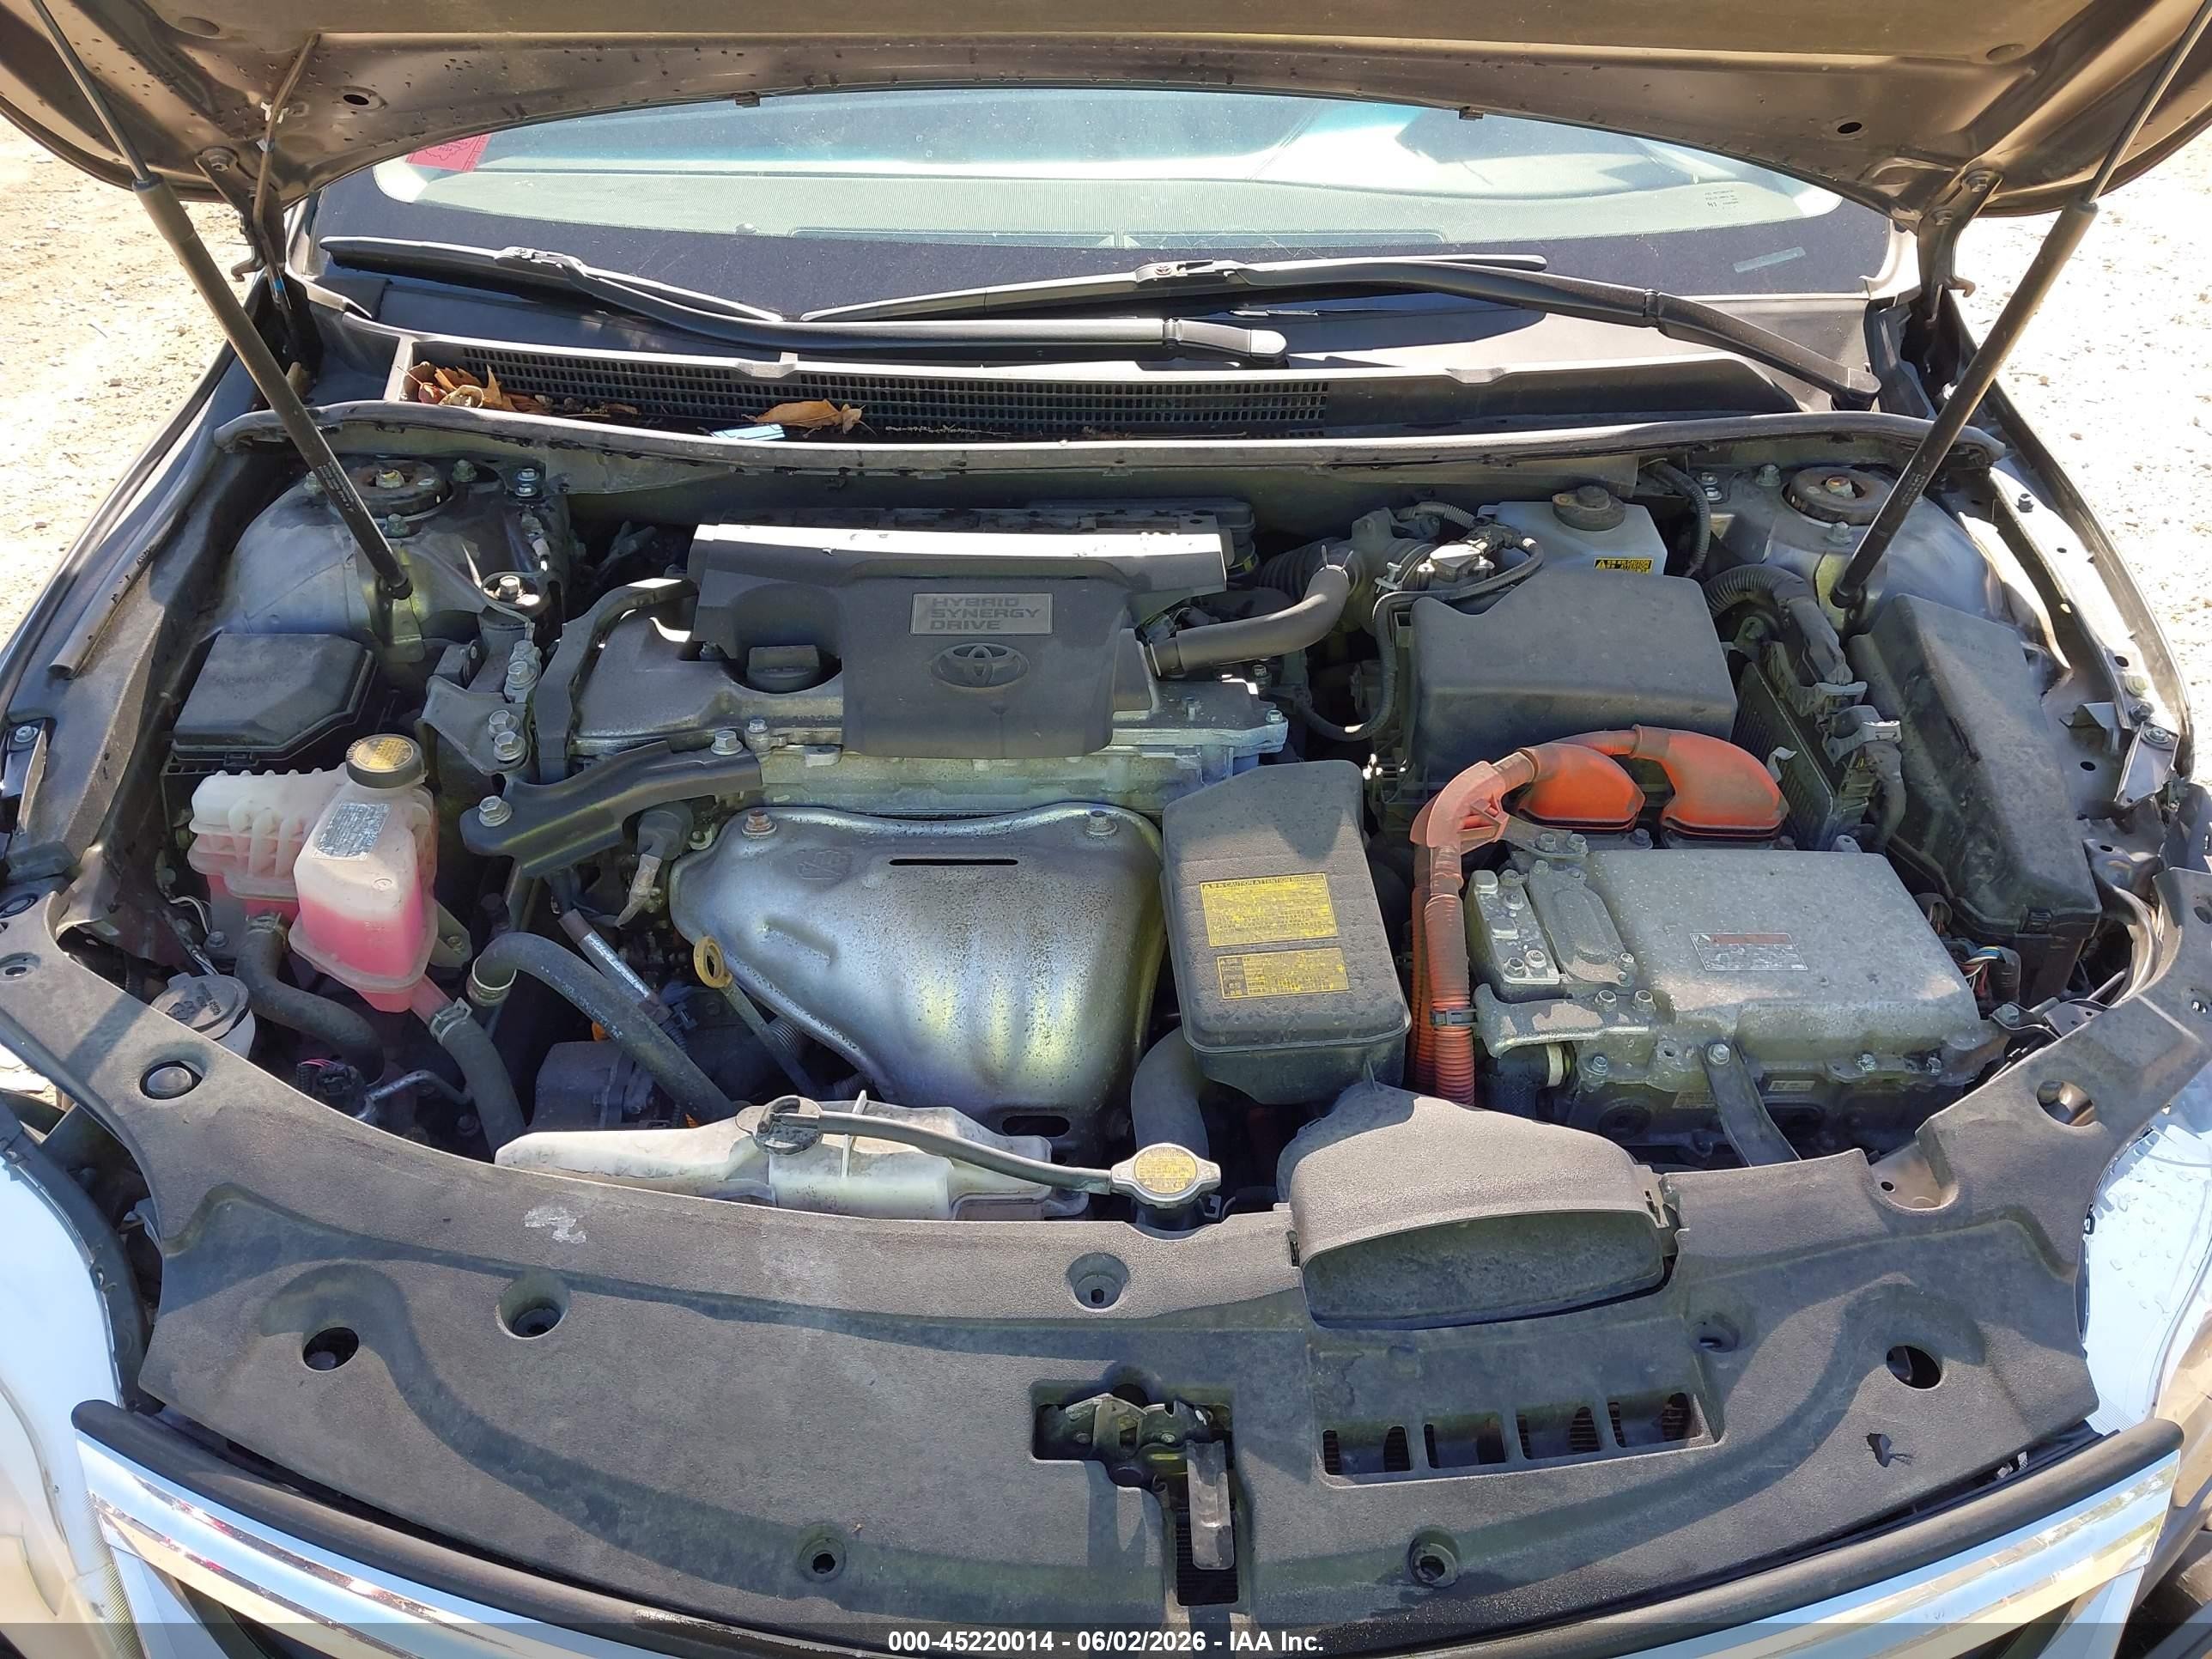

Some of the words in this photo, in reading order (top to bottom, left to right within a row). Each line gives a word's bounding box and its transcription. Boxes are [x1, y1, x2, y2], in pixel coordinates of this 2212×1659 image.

[933, 598, 1020, 607] HYBRID
[931, 608, 1040, 618] SYNERGY
[930, 620, 1001, 630] DRIVE
[1255, 877, 1291, 886] ATTENTION
